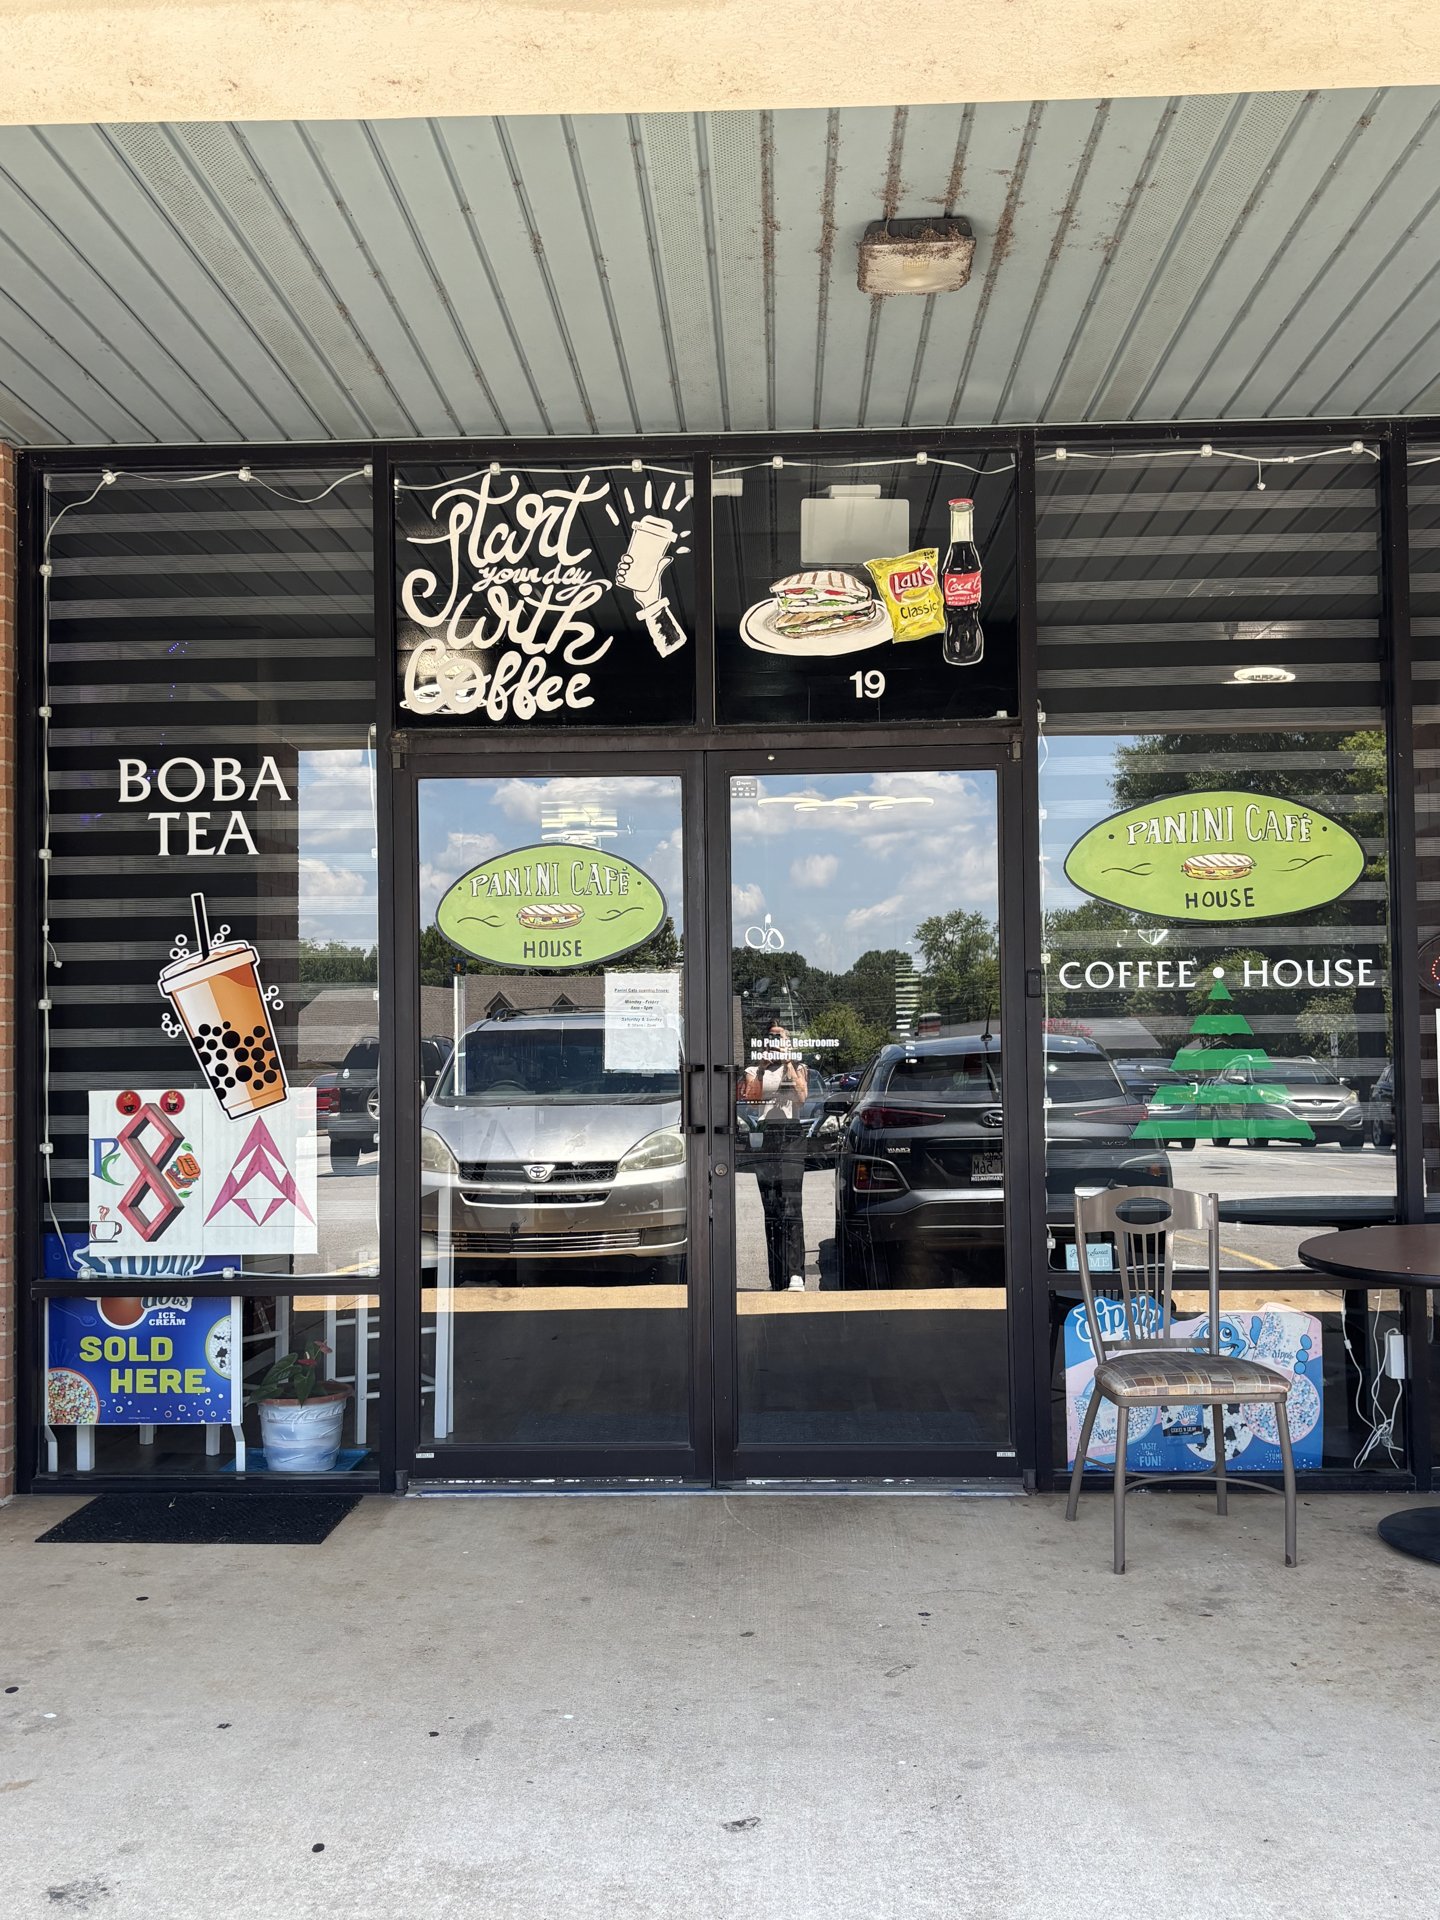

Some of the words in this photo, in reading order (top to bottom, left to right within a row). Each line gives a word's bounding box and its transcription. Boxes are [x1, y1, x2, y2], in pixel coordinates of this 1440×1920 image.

[900, 600, 938, 619] Classic
[850, 670, 886, 699] 19
[118, 756, 292, 803] BOBA
[148, 811, 260, 856] TEA
[1126, 806, 1234, 845] PANINI
[470, 862, 560, 898] PANINI
[1185, 887, 1256, 908] HOUSE
[523, 940, 583, 959] HOUSE
[1059, 960, 1196, 990] COFFEE
[1243, 959, 1376, 988] HOUSE
[751, 1038, 762, 1048] No
[763, 1038, 792, 1048] Public
[793, 1038, 840, 1048] Restrooms
[751, 1051, 763, 1060] No
[1071, 1258, 1109, 1268] HME
[80, 1336, 173, 1362] SOLD
[110, 1369, 206, 1394] HERE
[1140, 1455, 1161, 1466] FUN!
